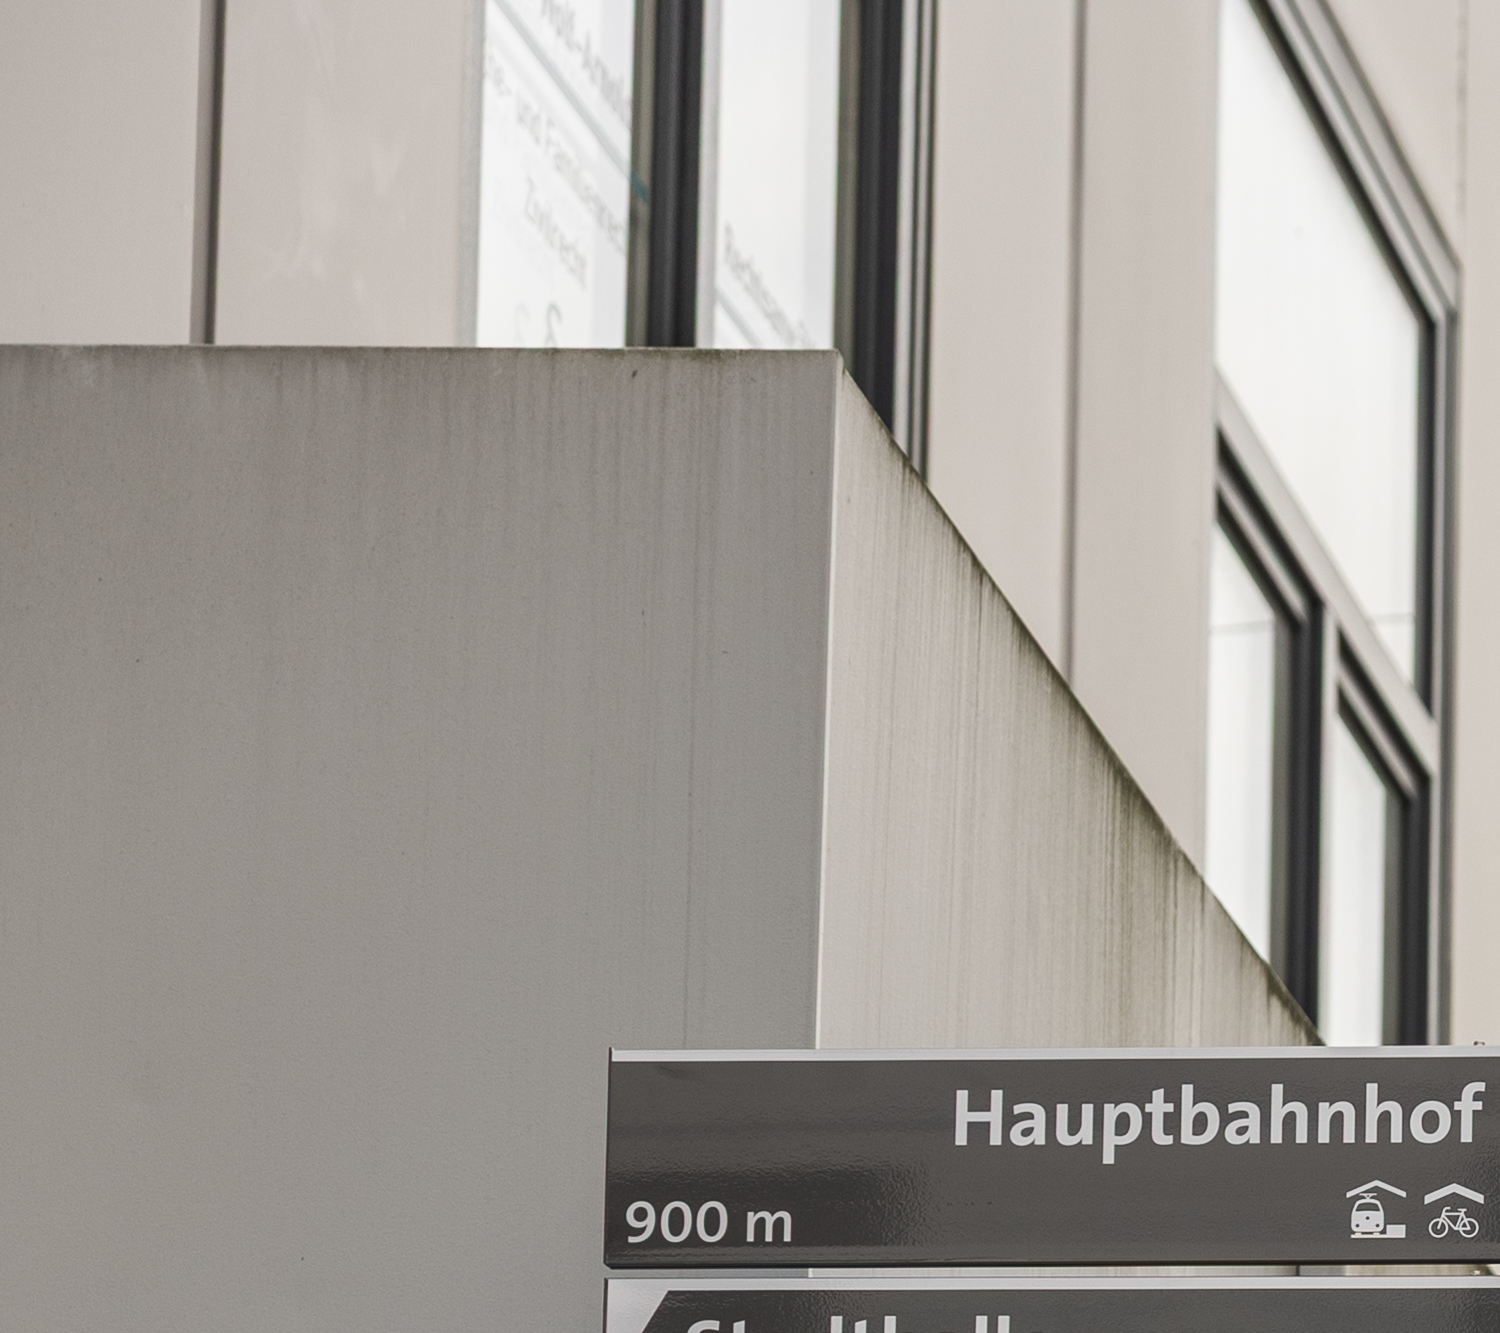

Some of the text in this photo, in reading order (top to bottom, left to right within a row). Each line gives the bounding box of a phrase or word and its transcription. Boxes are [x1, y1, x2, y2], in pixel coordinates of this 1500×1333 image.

[953, 1081, 1486, 1165] Hauptbahnhof
[625, 1200, 793, 1243] 900 m
